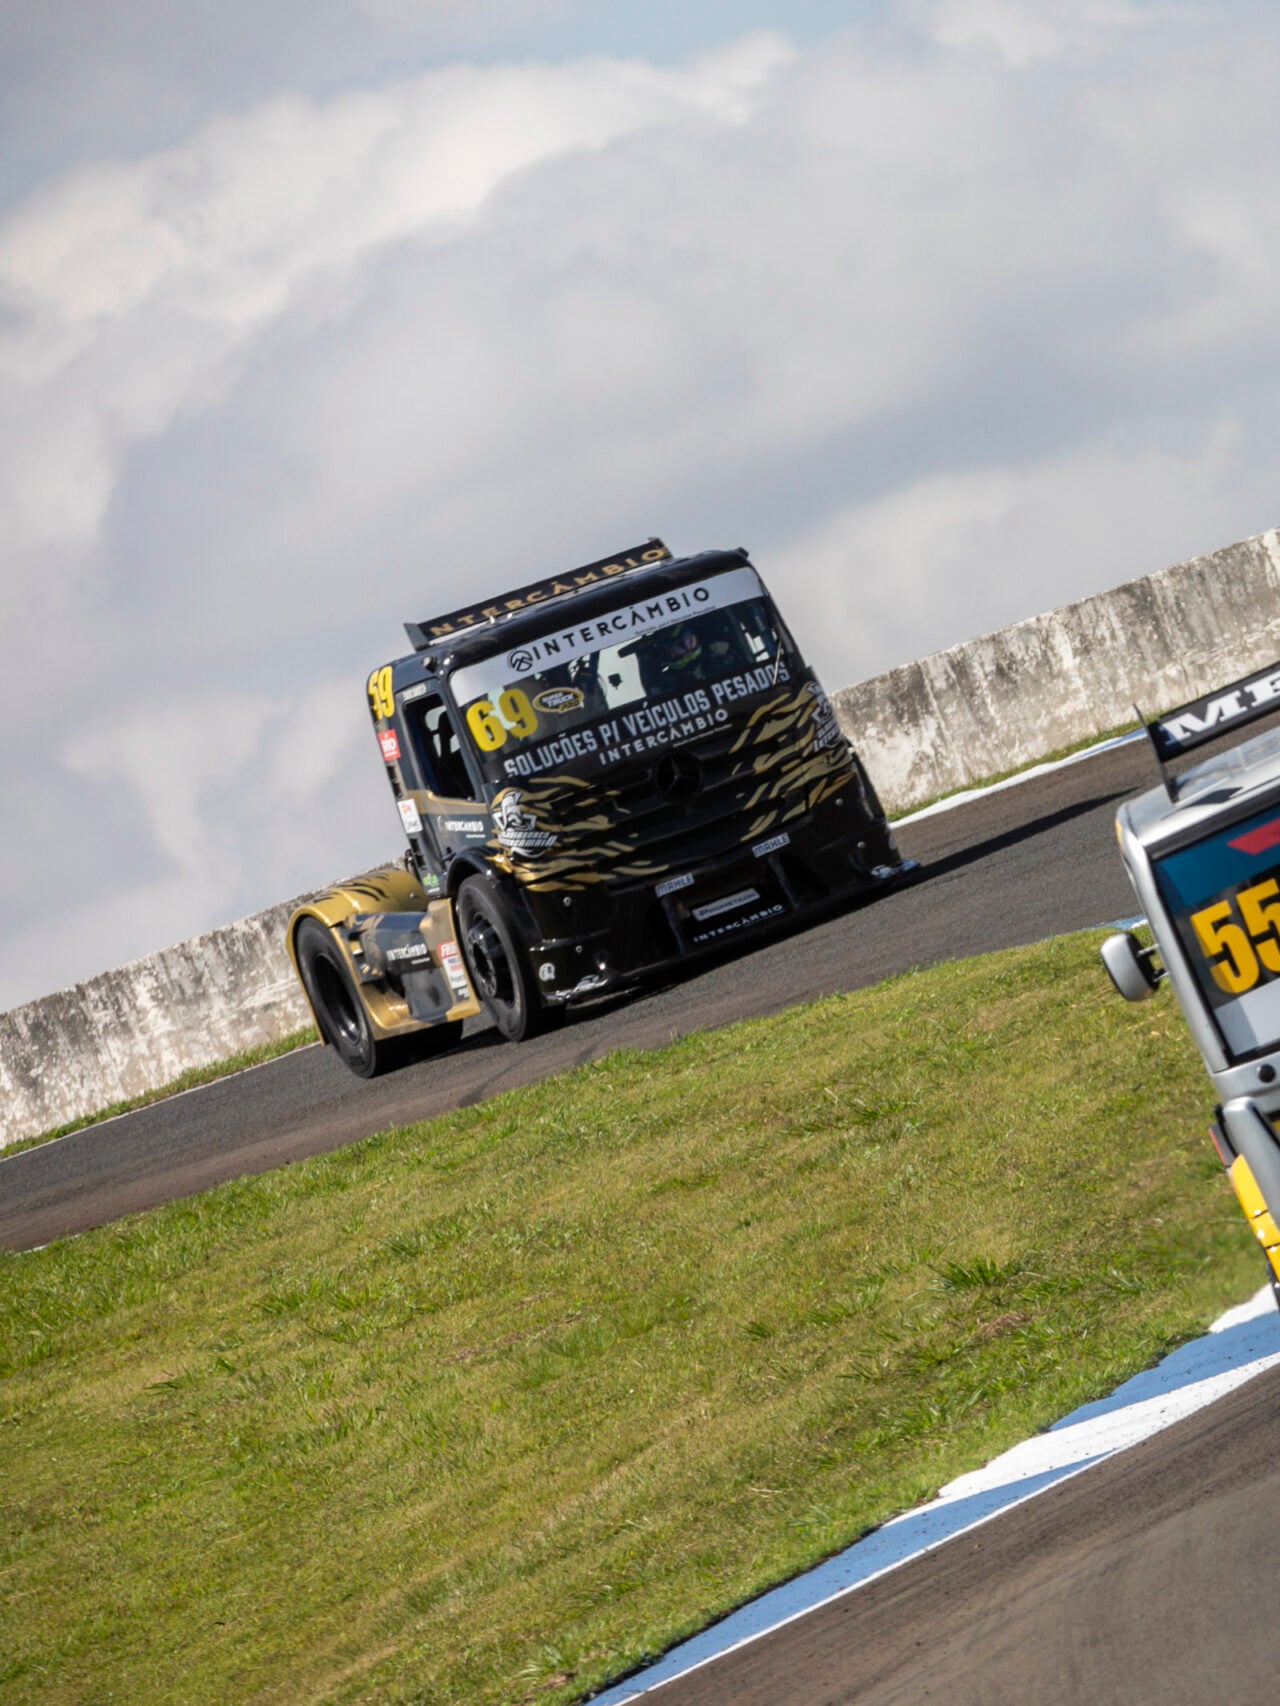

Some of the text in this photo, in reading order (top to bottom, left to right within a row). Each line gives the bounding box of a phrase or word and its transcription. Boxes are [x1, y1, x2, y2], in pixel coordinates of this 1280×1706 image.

[533, 587, 710, 661] INTERCÂMBIO
[466, 687, 539, 752] 69
[622, 688, 712, 736] VEÍCULOS
[711, 661, 791, 704] PESADOS
[599, 708, 729, 766] INTERCÂMBIO
